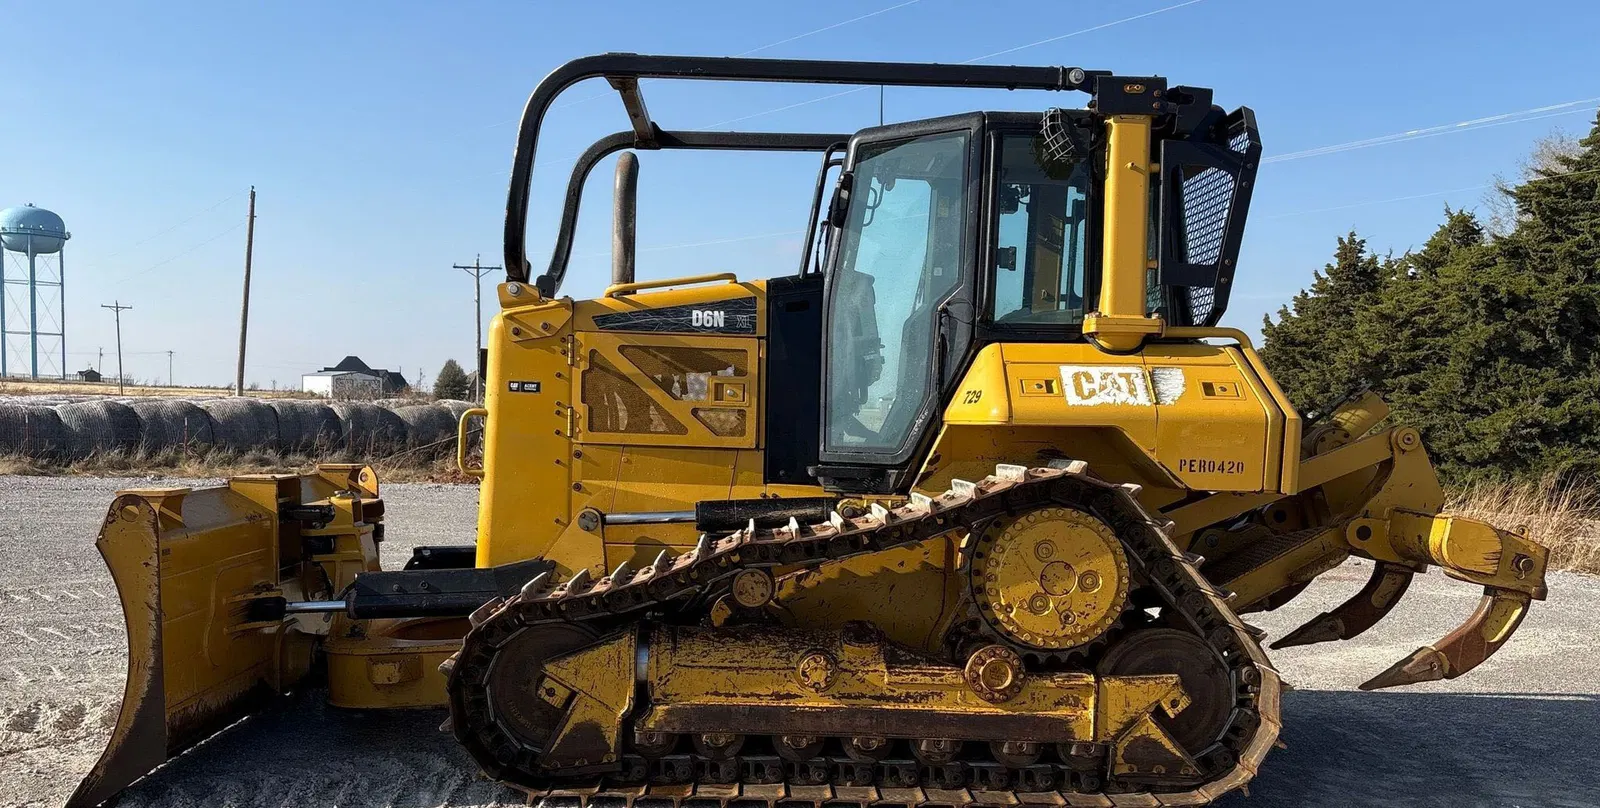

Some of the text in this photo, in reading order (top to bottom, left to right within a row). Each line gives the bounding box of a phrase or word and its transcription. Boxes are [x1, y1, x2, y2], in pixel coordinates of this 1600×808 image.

[692, 310, 724, 327] D6N
[1071, 371, 1139, 401] CAT
[963, 390, 982, 404] 729
